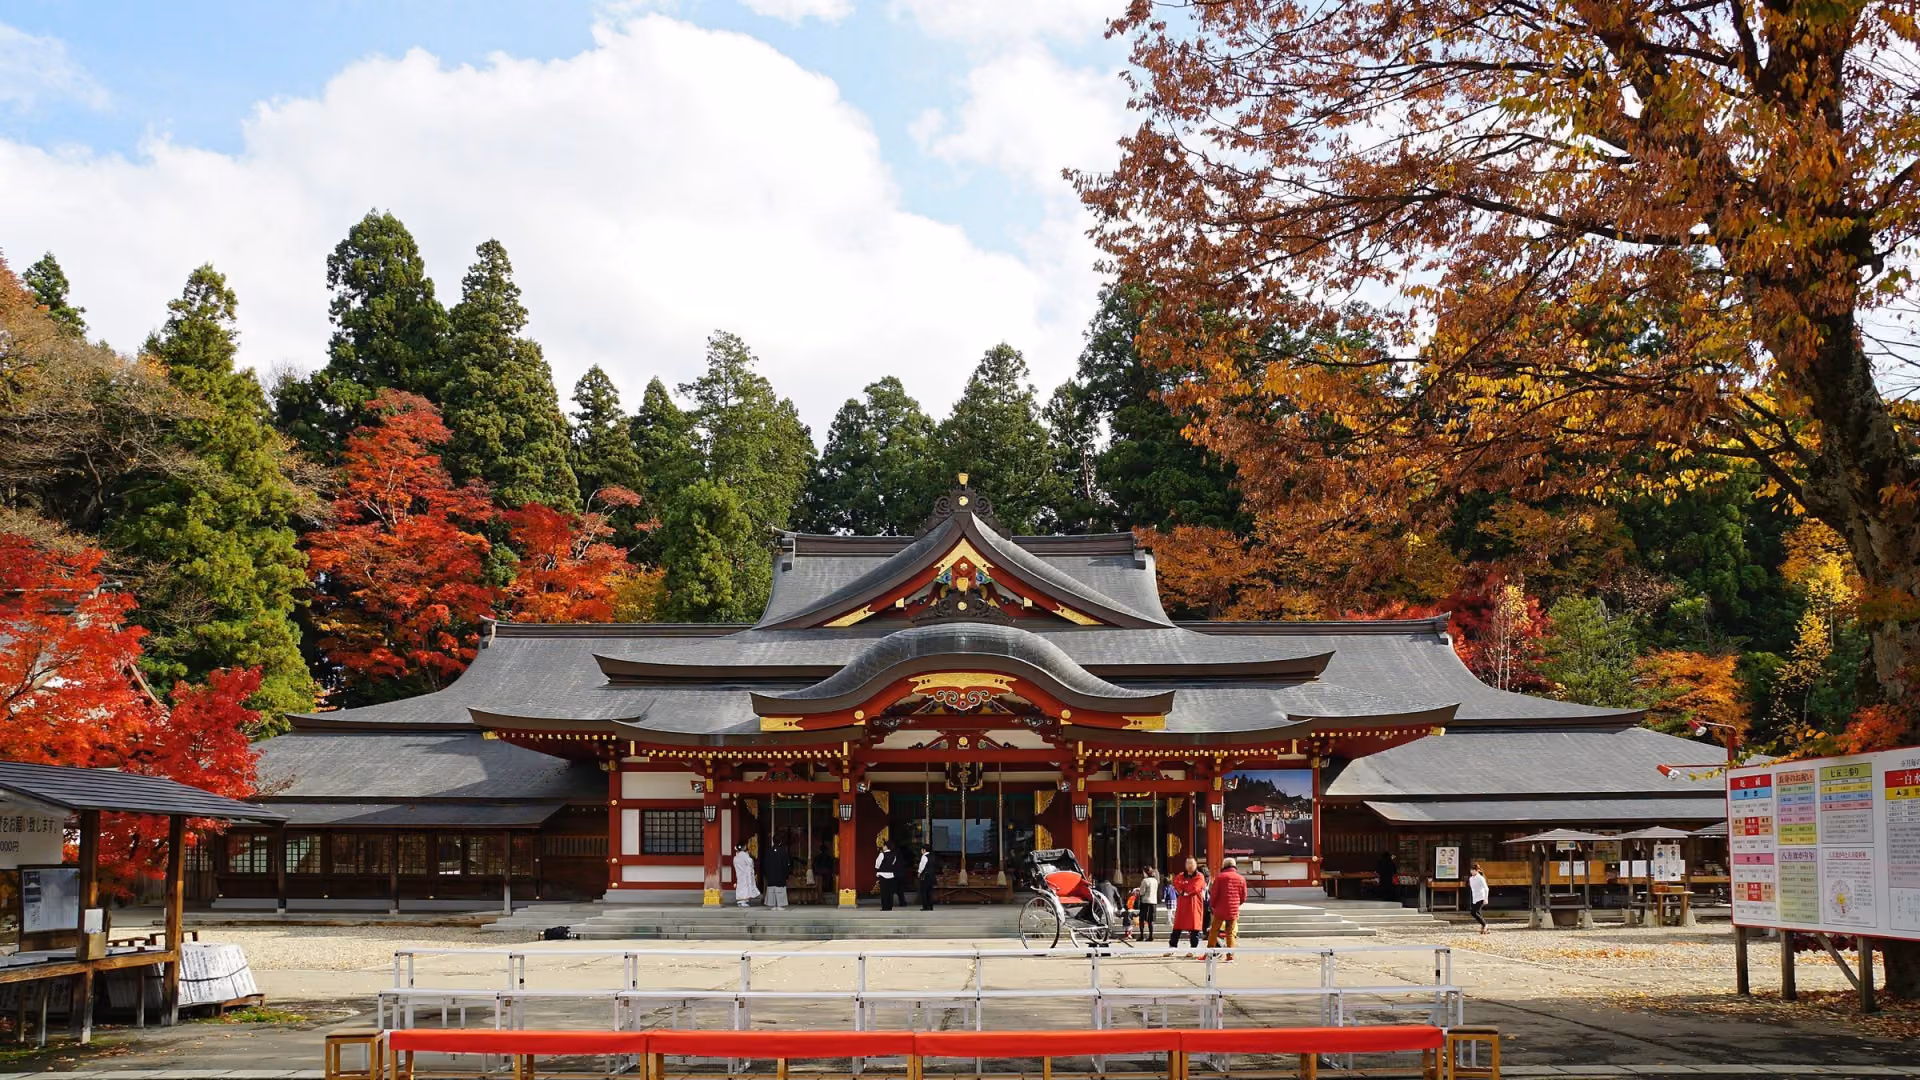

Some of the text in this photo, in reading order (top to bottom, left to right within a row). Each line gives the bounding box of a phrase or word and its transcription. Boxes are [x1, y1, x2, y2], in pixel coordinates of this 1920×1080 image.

[0, 816, 57, 834] をお願い致します。
